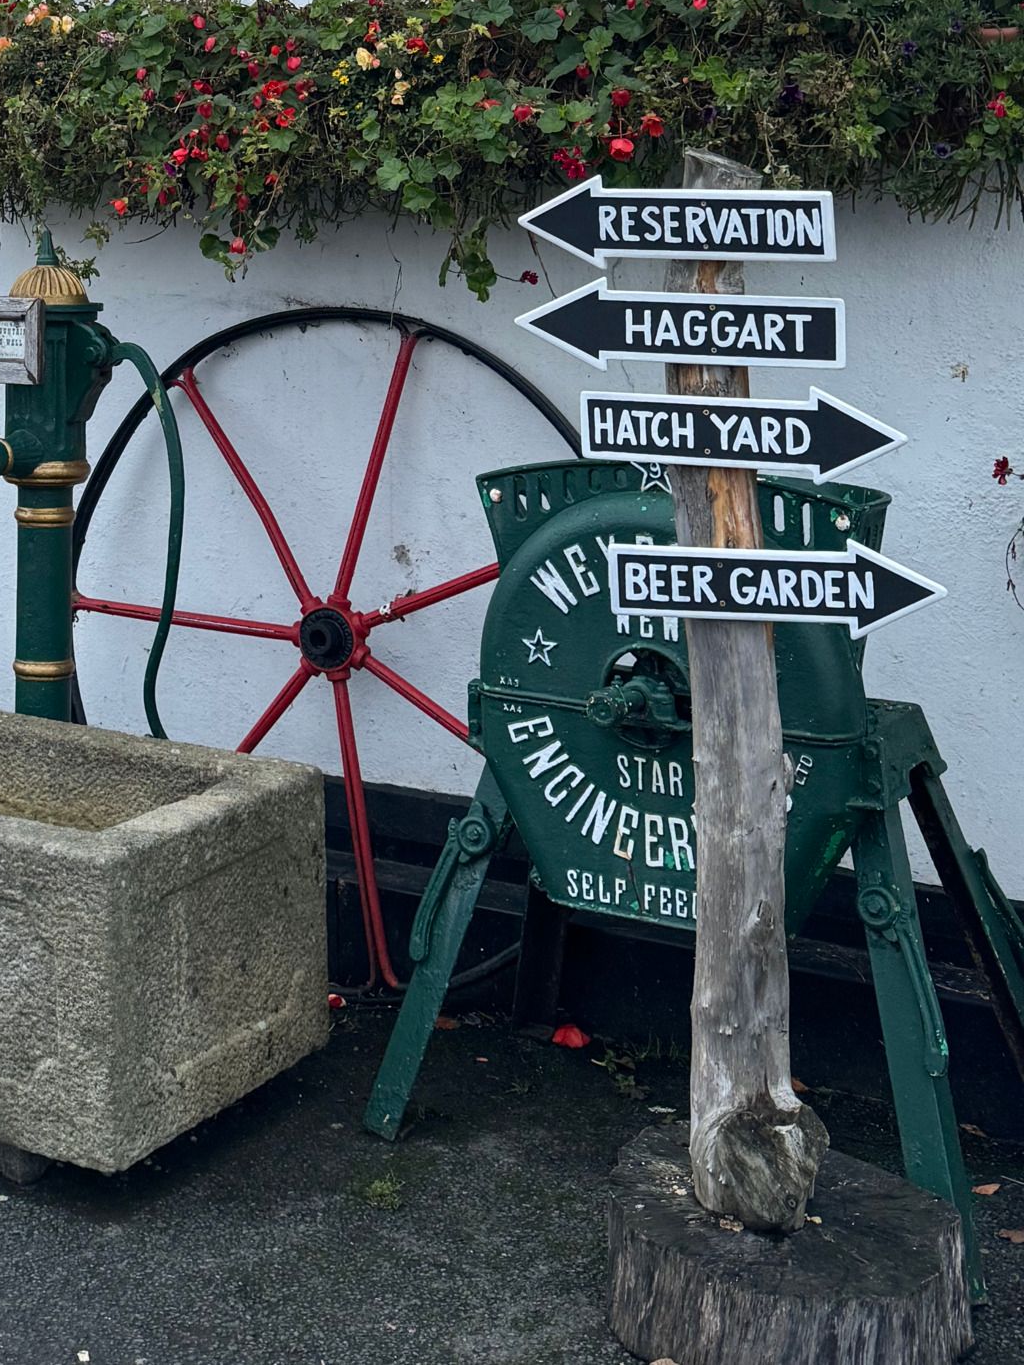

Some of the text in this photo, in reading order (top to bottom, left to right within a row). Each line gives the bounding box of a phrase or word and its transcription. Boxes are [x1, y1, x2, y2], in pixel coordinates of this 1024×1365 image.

[598, 205, 823, 248] RESERVATION
[625, 309, 812, 353] HAGGART
[593, 406, 811, 456] HATCH YARD
[624, 561, 717, 604] BEER
[729, 569, 875, 610] GARDEN
[616, 754, 683, 797] STAR
[795, 754, 814, 786] LTD
[507, 715, 697, 871] ENGINEER
[567, 869, 627, 905] SELF
